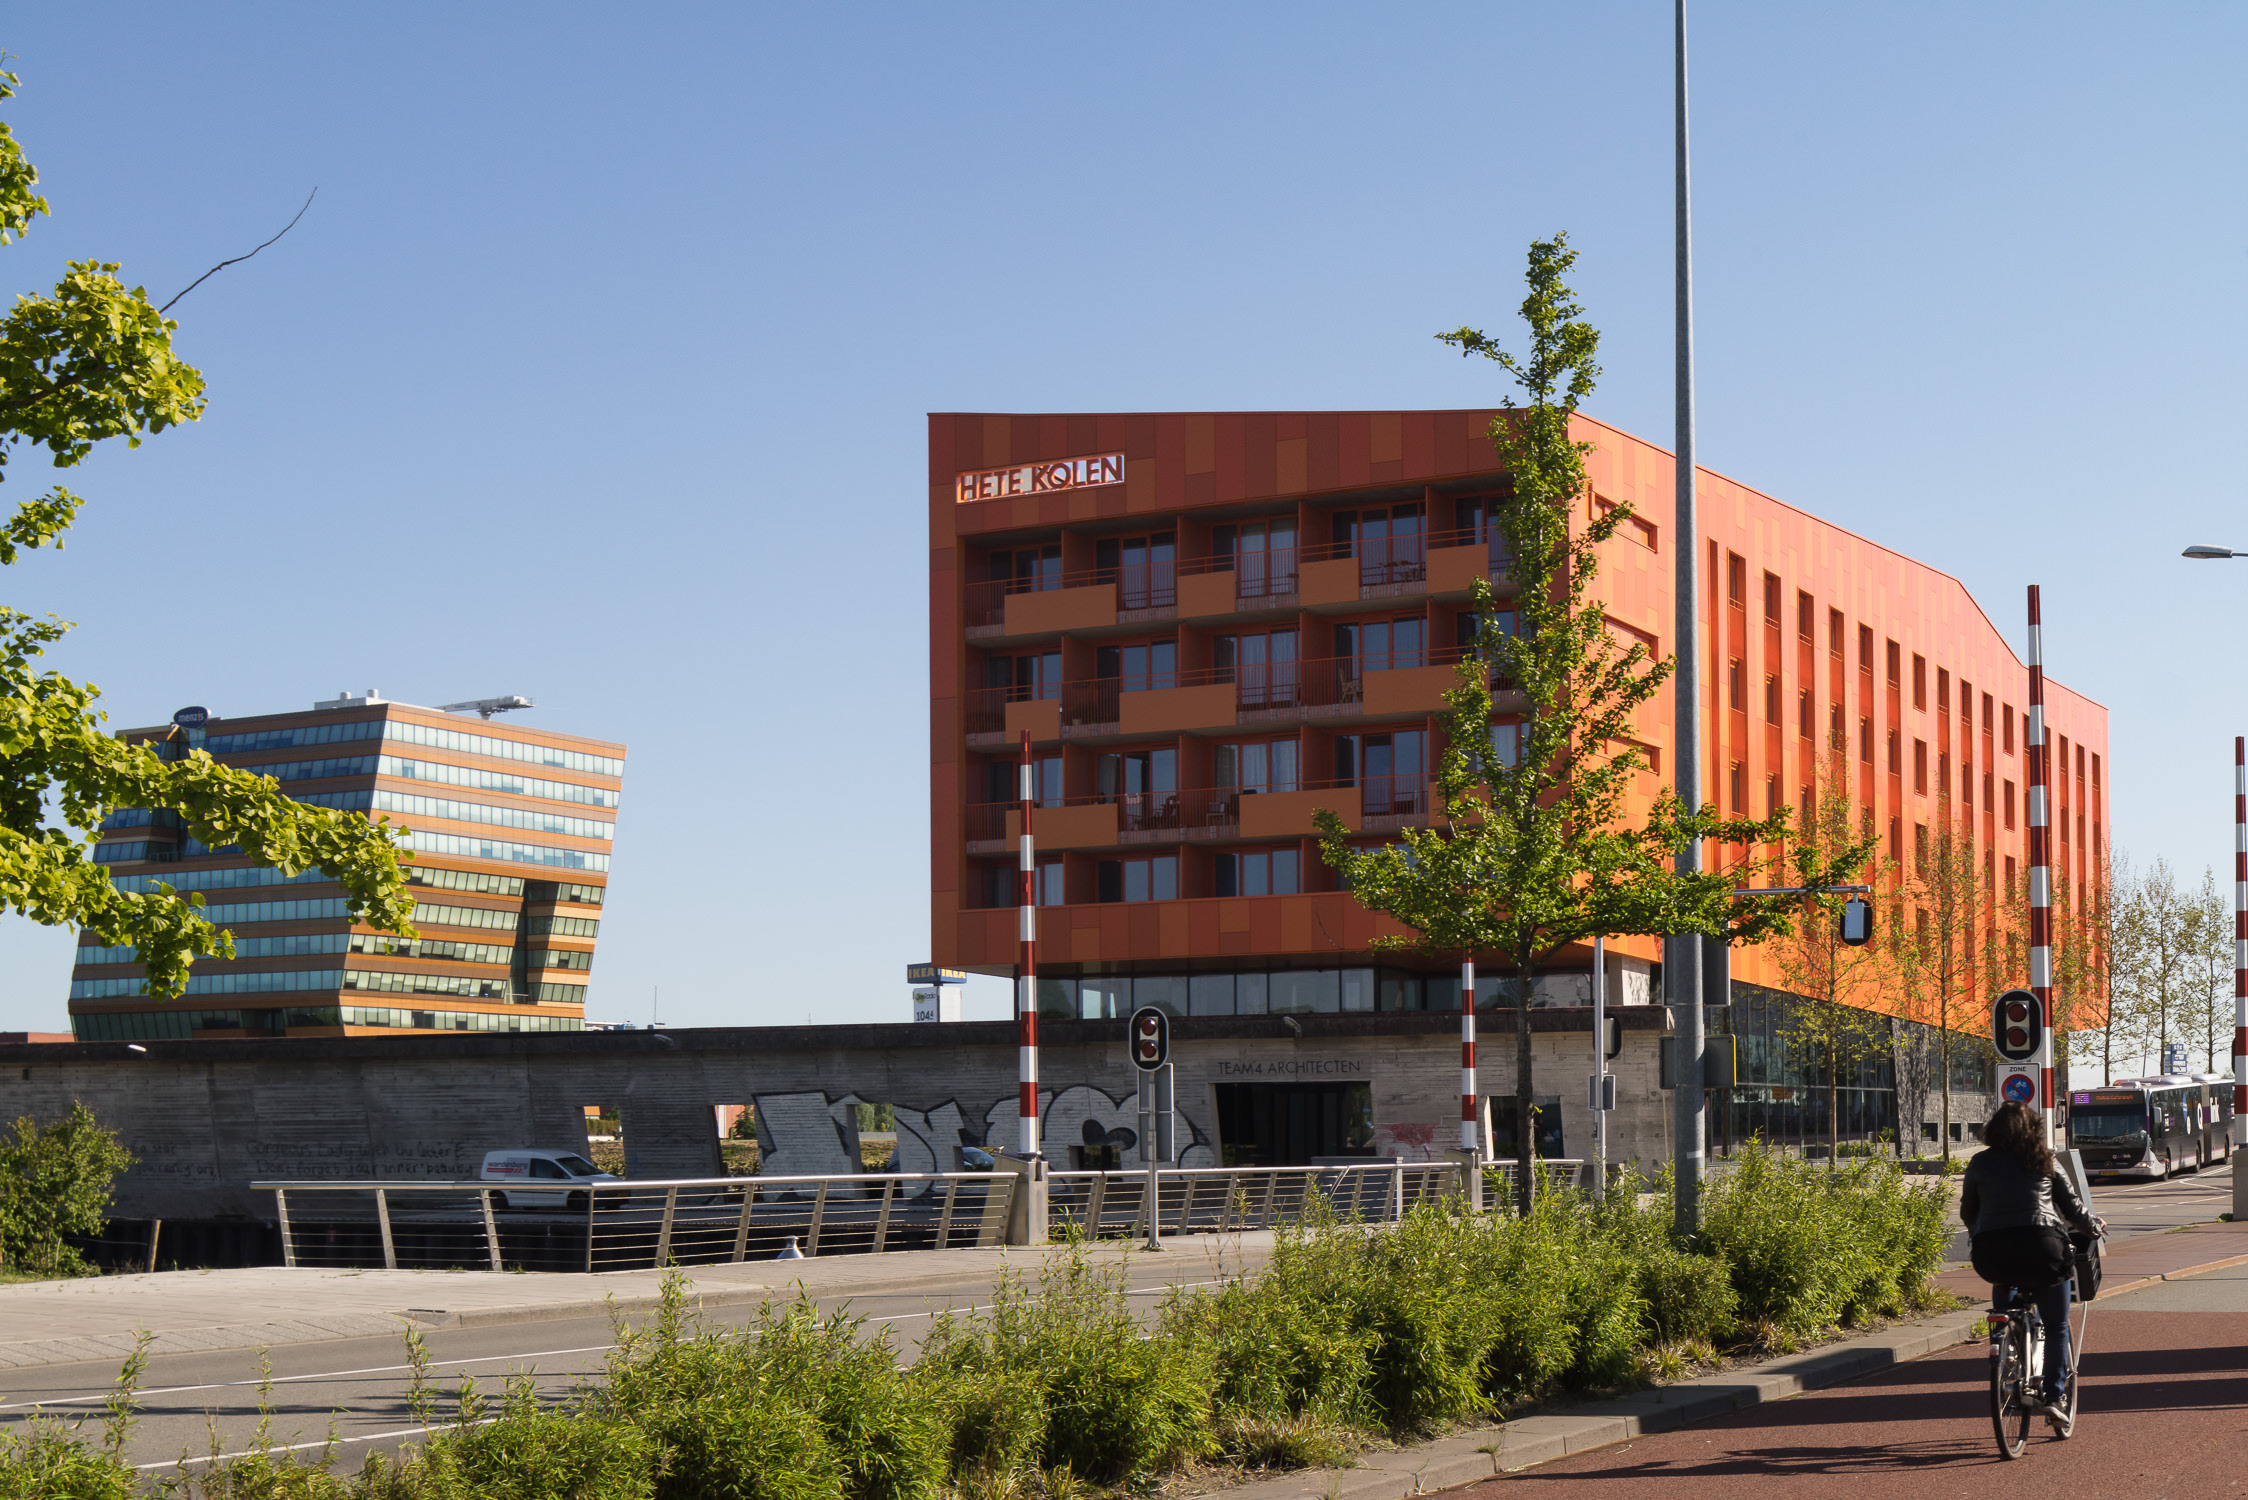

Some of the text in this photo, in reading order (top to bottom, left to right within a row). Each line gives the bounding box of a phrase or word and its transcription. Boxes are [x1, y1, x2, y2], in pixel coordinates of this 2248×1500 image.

[960, 455, 1124, 501] HETE KOLEN
[179, 712, 204, 722] menzis
[907, 967, 935, 979] IKEA
[941, 968, 966, 979] IKEA
[1218, 1060, 1361, 1075] TEAM4 ARCHITECTEN
